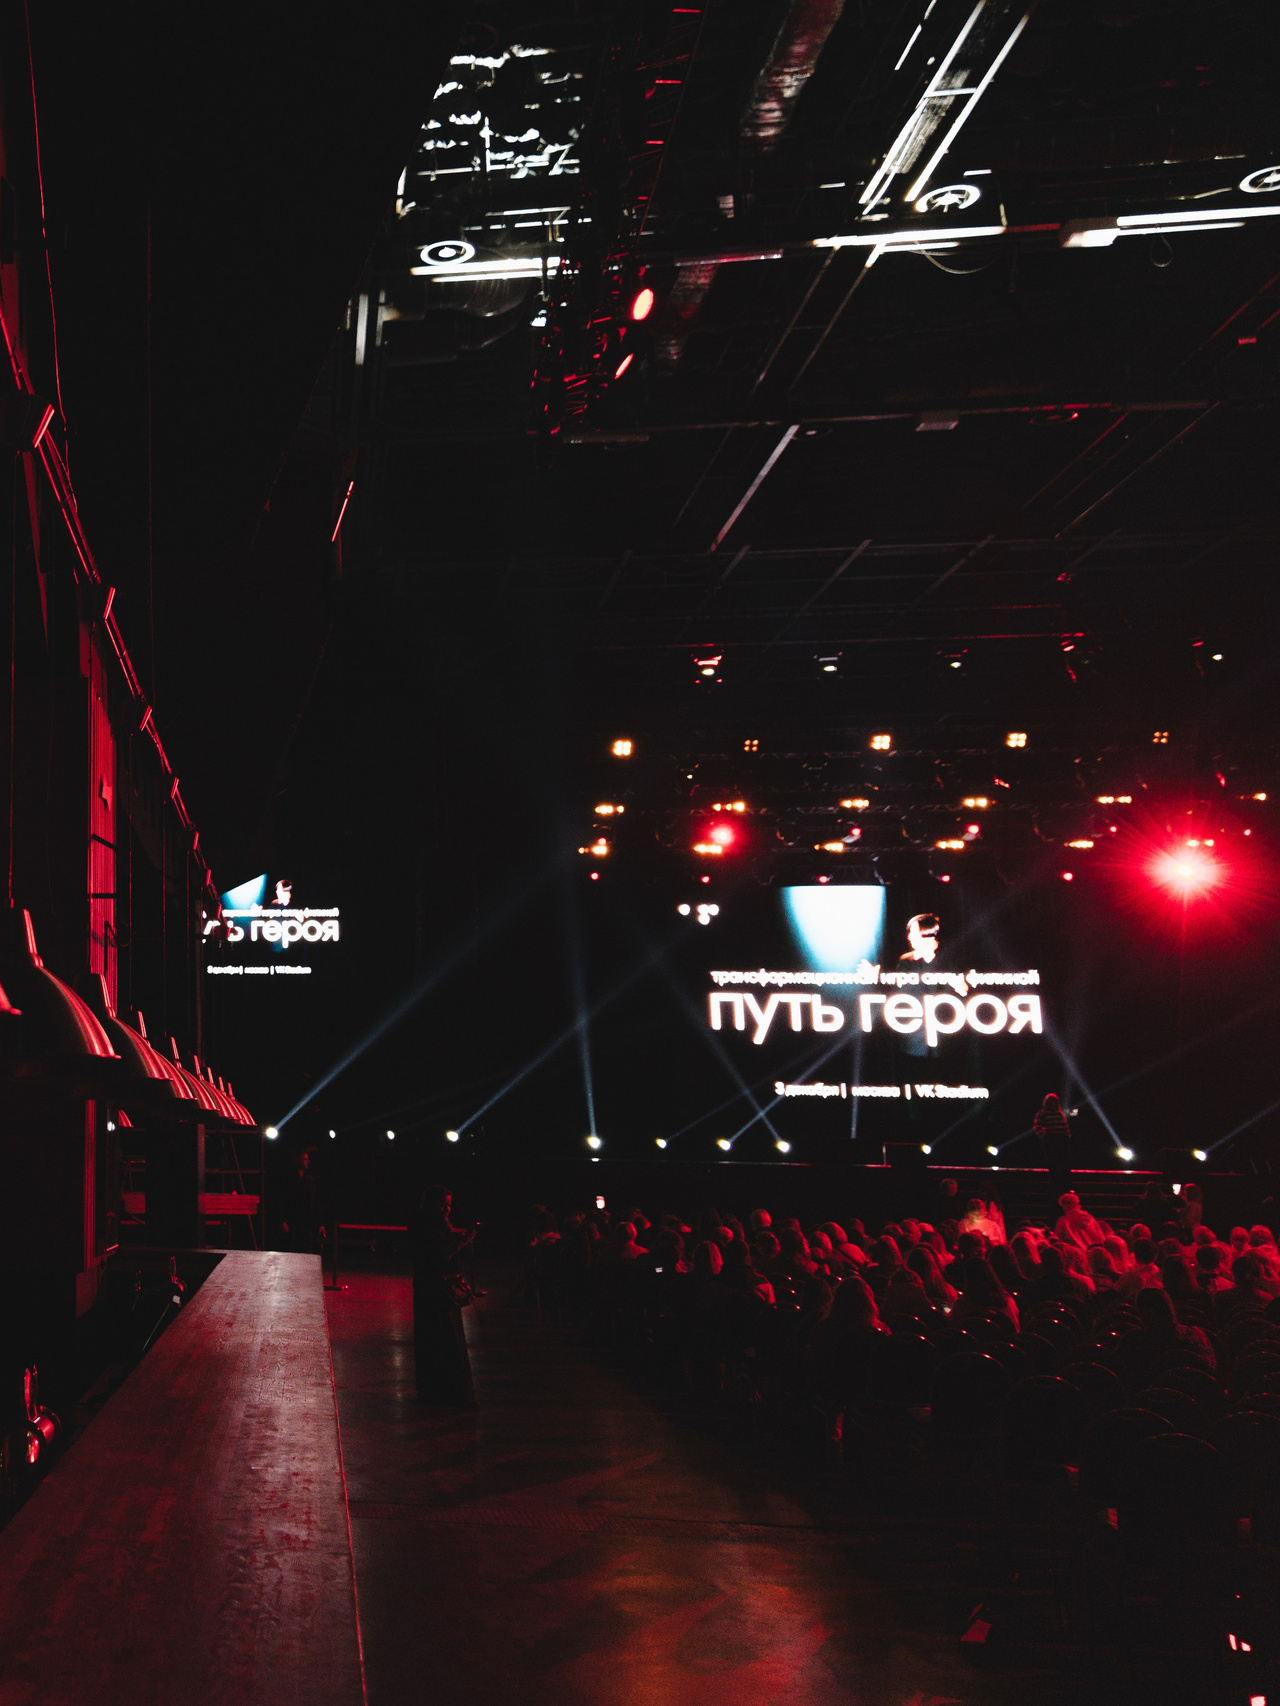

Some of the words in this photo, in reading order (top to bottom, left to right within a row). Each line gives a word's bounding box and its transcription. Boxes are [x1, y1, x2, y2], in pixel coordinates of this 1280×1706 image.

[250, 919, 340, 949] героя
[708, 992, 845, 1045] путь
[859, 993, 1043, 1048] героя
[774, 1081, 785, 1096] 3
